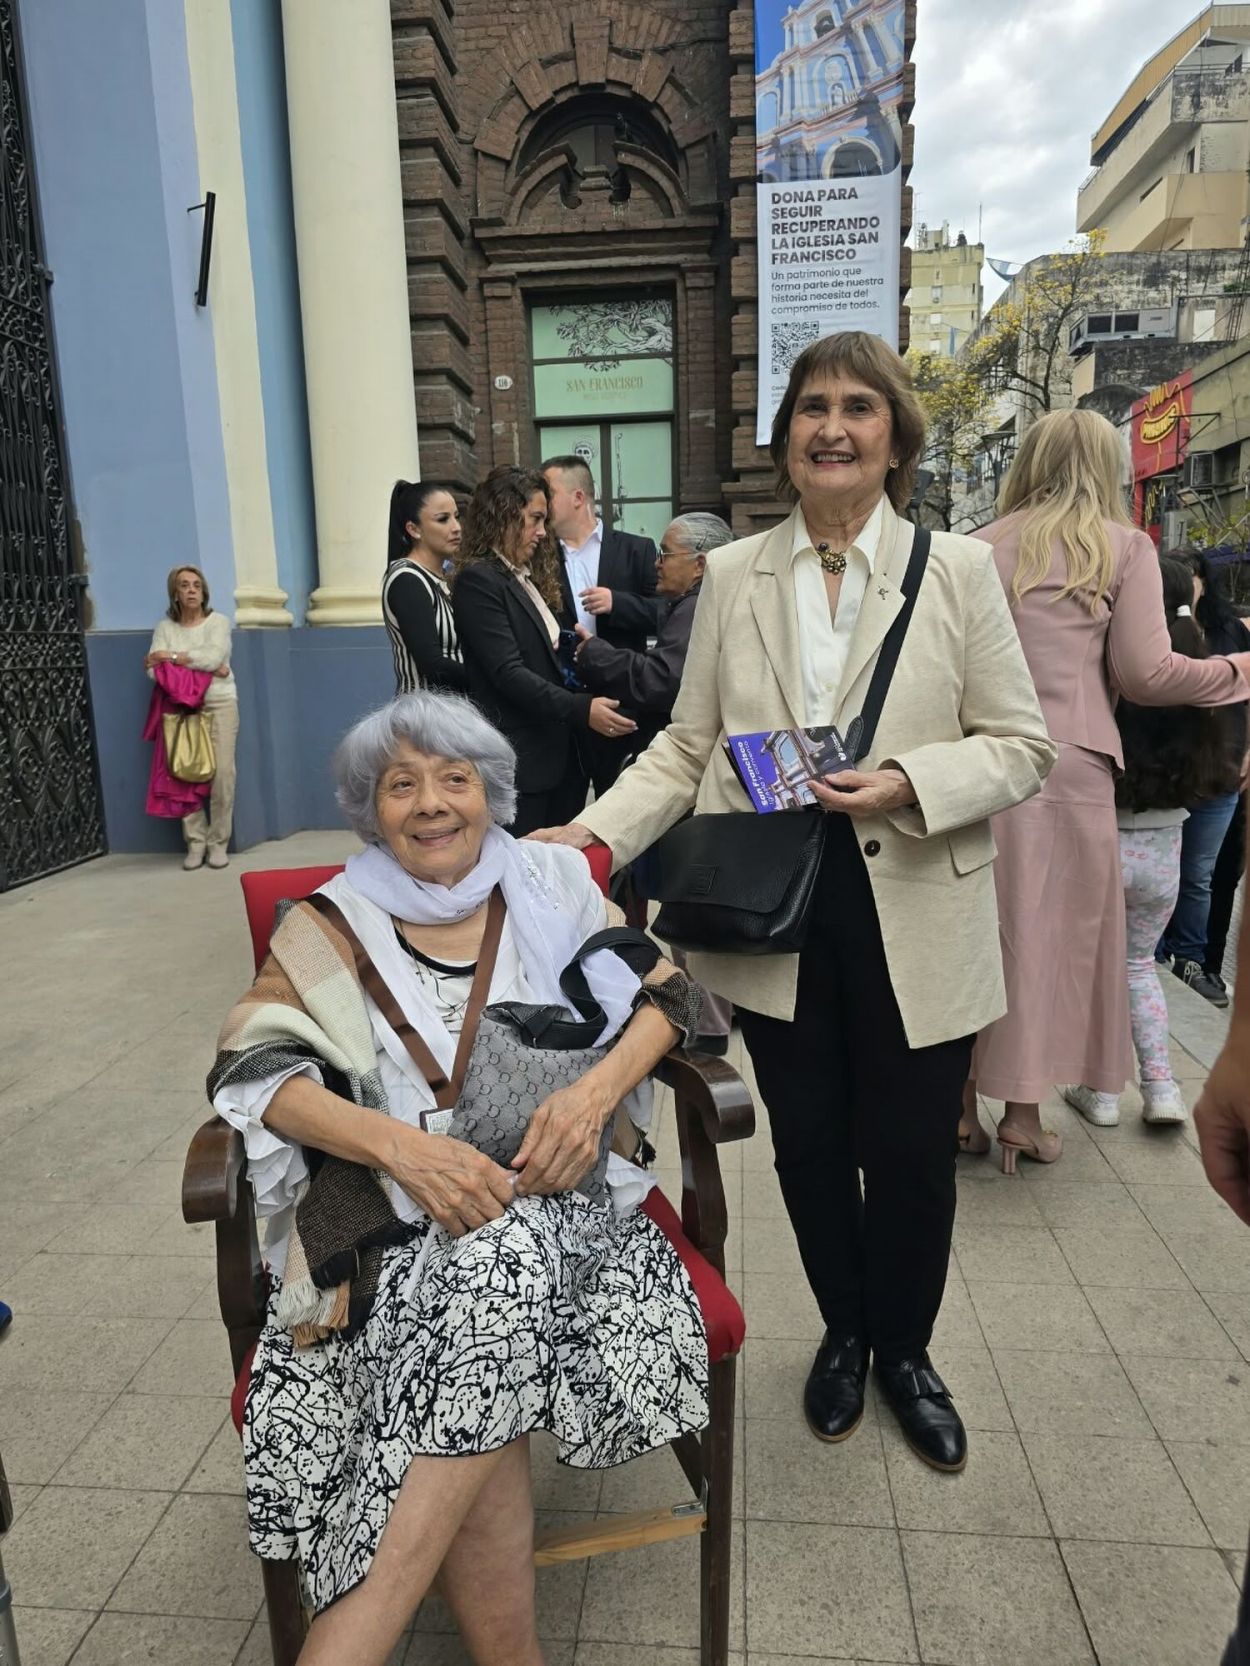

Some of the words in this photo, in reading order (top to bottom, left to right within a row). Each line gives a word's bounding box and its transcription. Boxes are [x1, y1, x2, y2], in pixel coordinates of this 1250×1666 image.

[771, 190, 815, 205] DONA
[817, 187, 859, 202] PARA
[771, 205, 823, 220] SEGUIR
[771, 216, 880, 235] RECUPERANDO
[771, 238, 789, 250] LA
[791, 234, 846, 249] IGLESIA
[847, 231, 879, 245] SAN
[771, 248, 856, 265] FRANCISCO
[771, 271, 785, 281] Un
[786, 267, 840, 282] patrimonio
[842, 267, 862, 278] que
[771, 282, 800, 292] forma
[803, 279, 829, 292] parte
[831, 279, 844, 288] de
[846, 277, 884, 287] nuestra
[771, 293, 807, 304] historia
[809, 290, 851, 301] necesita
[853, 289, 869, 298] del
[771, 302, 832, 317] compromiso
[835, 301, 847, 310] de
[850, 300, 880, 310] todos.
[566, 378, 586, 392] SAN
[589, 375, 643, 391] FRANCISCO
